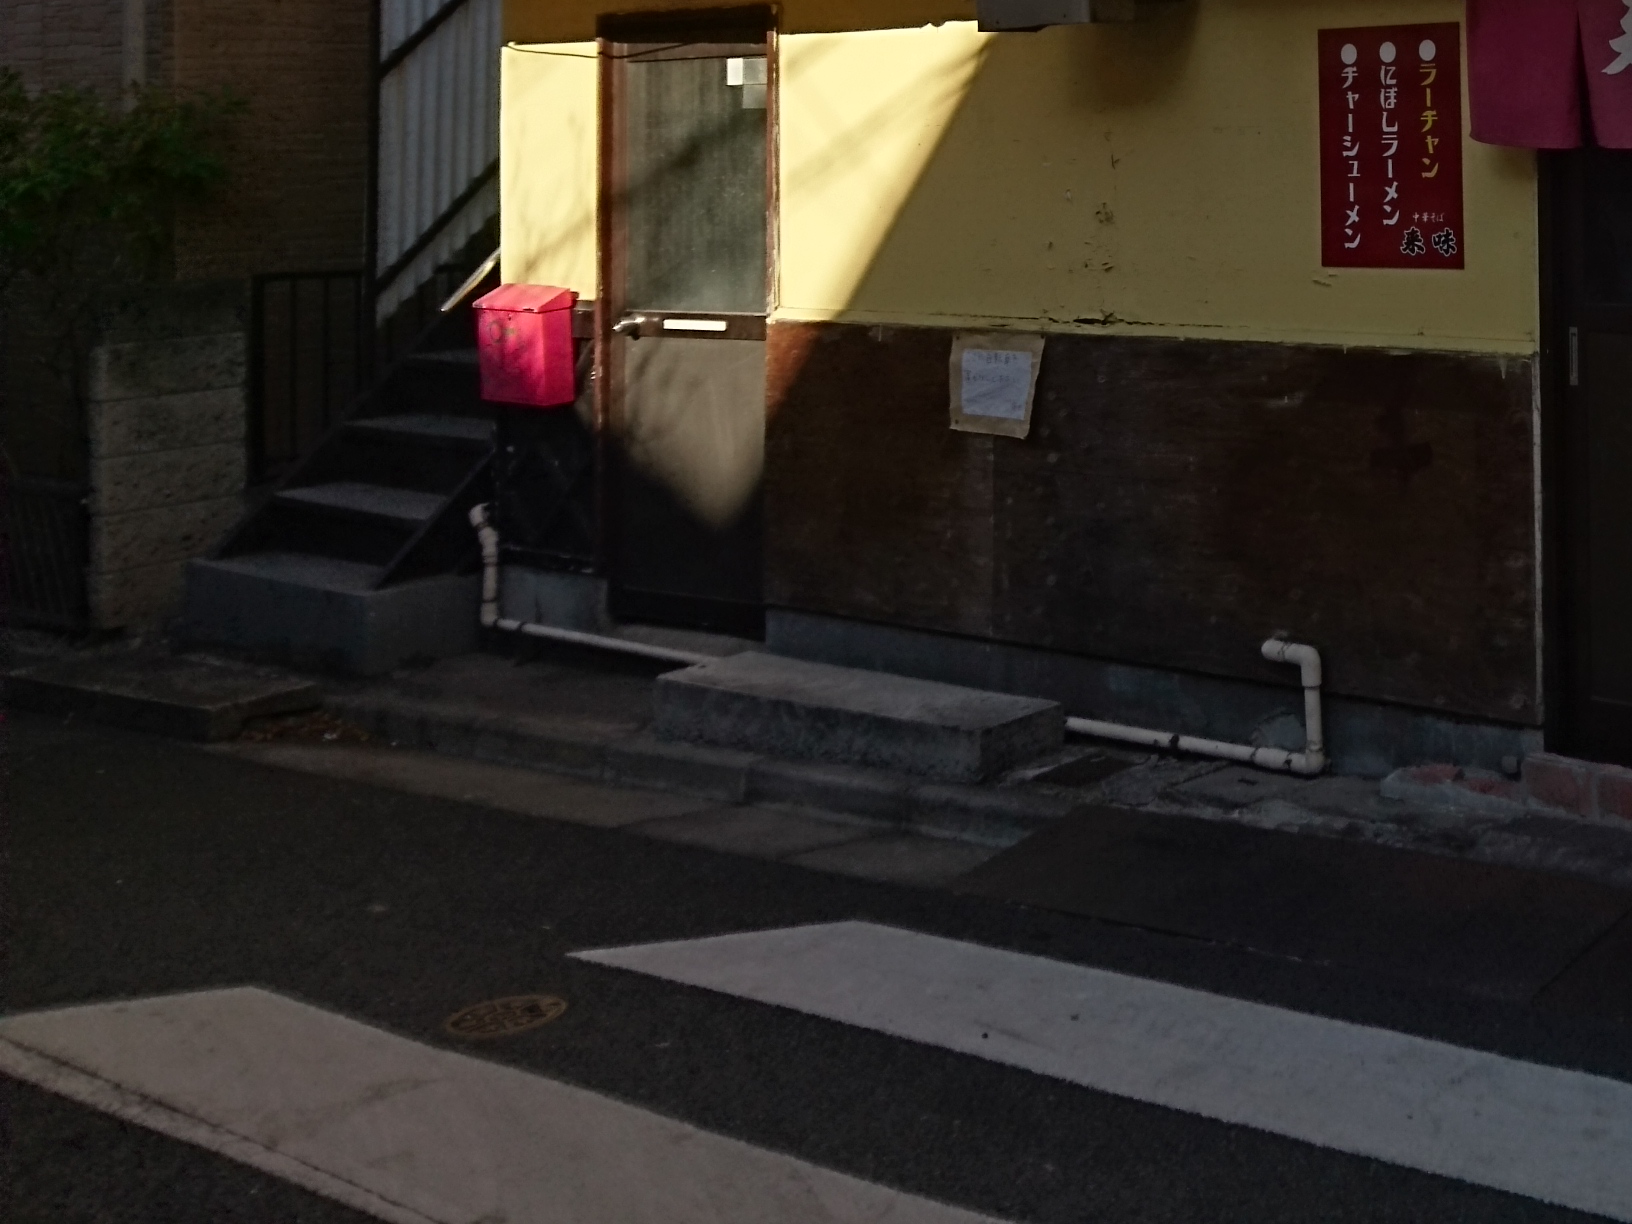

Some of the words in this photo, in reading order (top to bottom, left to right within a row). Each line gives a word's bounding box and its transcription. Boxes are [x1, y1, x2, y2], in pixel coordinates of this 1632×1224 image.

[1341, 66, 1361, 249] チャーシューメン
[1380, 65, 1400, 226] にぼしラーメン
[1419, 63, 1439, 178] ラーチャン
[1400, 227, 1457, 256] 来味
